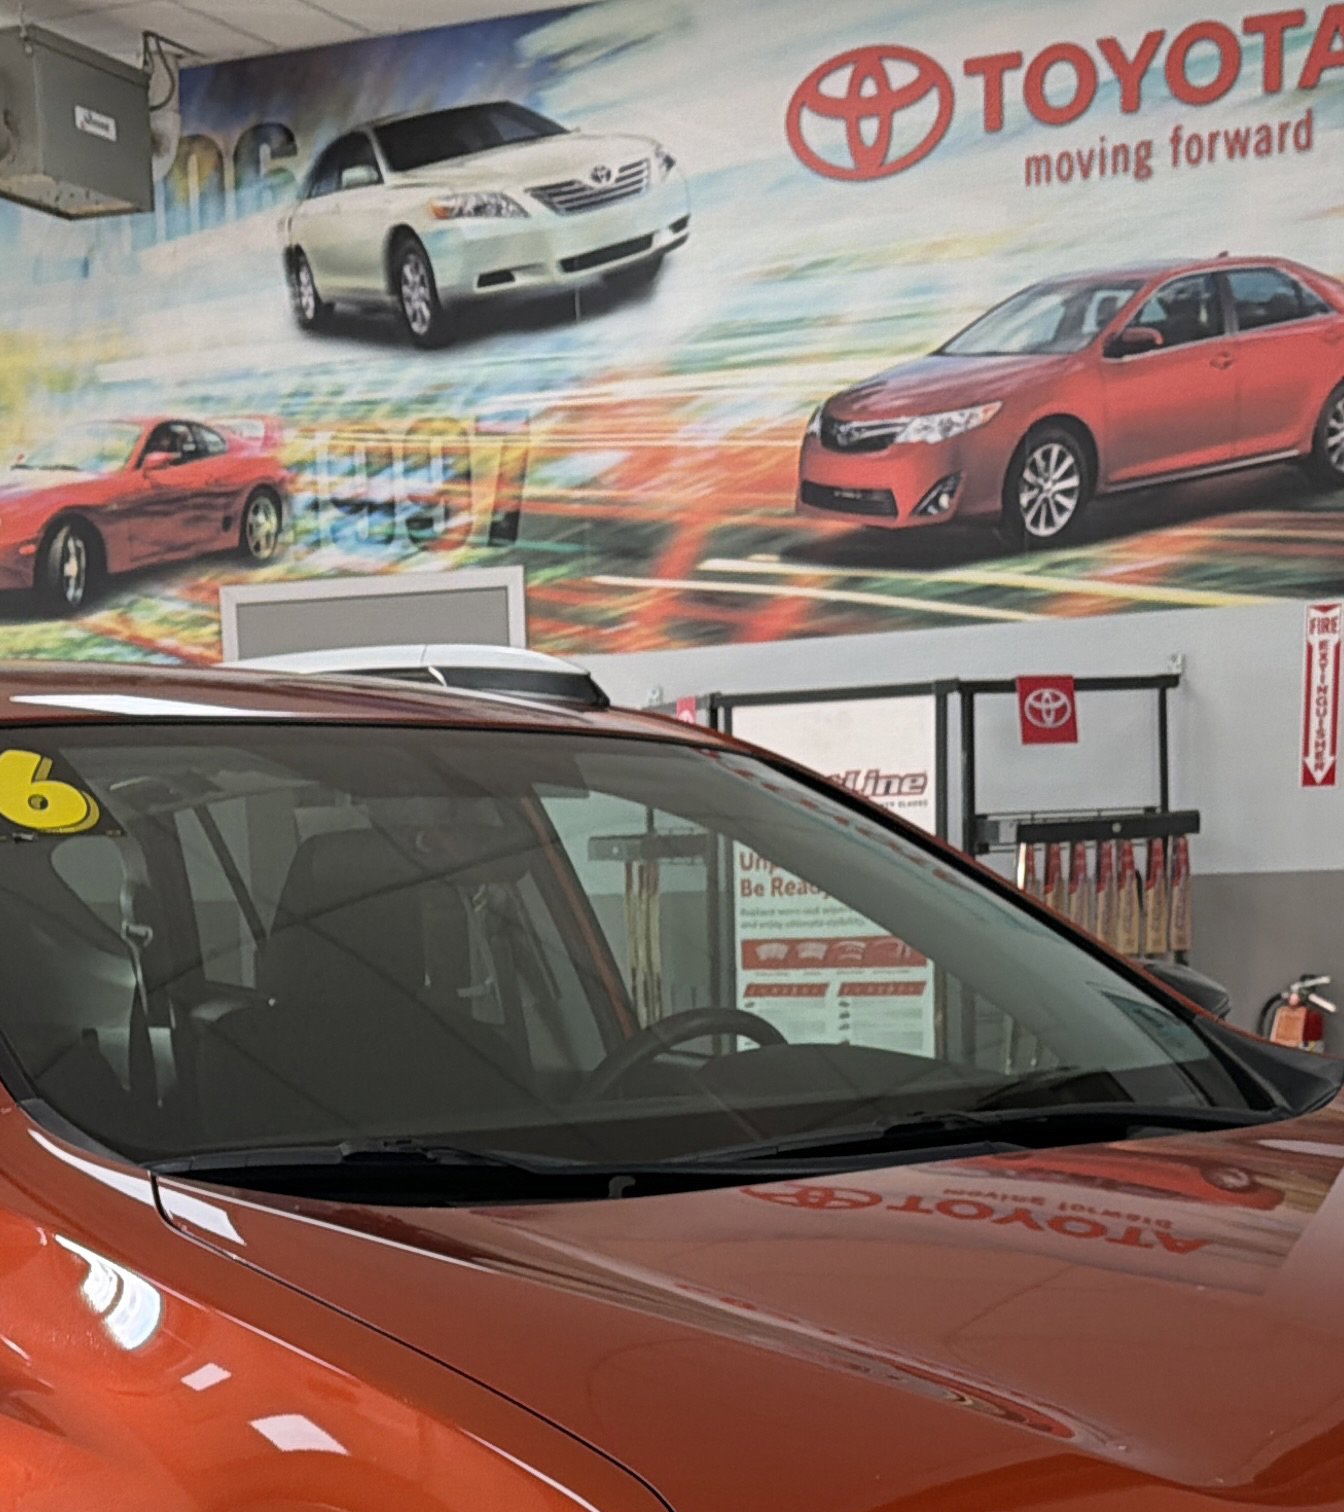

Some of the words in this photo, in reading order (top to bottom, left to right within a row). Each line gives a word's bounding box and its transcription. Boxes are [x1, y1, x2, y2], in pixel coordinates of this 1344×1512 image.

[1024, 137, 1154, 188] moving
[1170, 108, 1315, 169] forward
[1309, 616, 1339, 636] FIRE
[1314, 638, 1330, 773] EXTINGUISHER
[740, 878, 765, 898] Be
